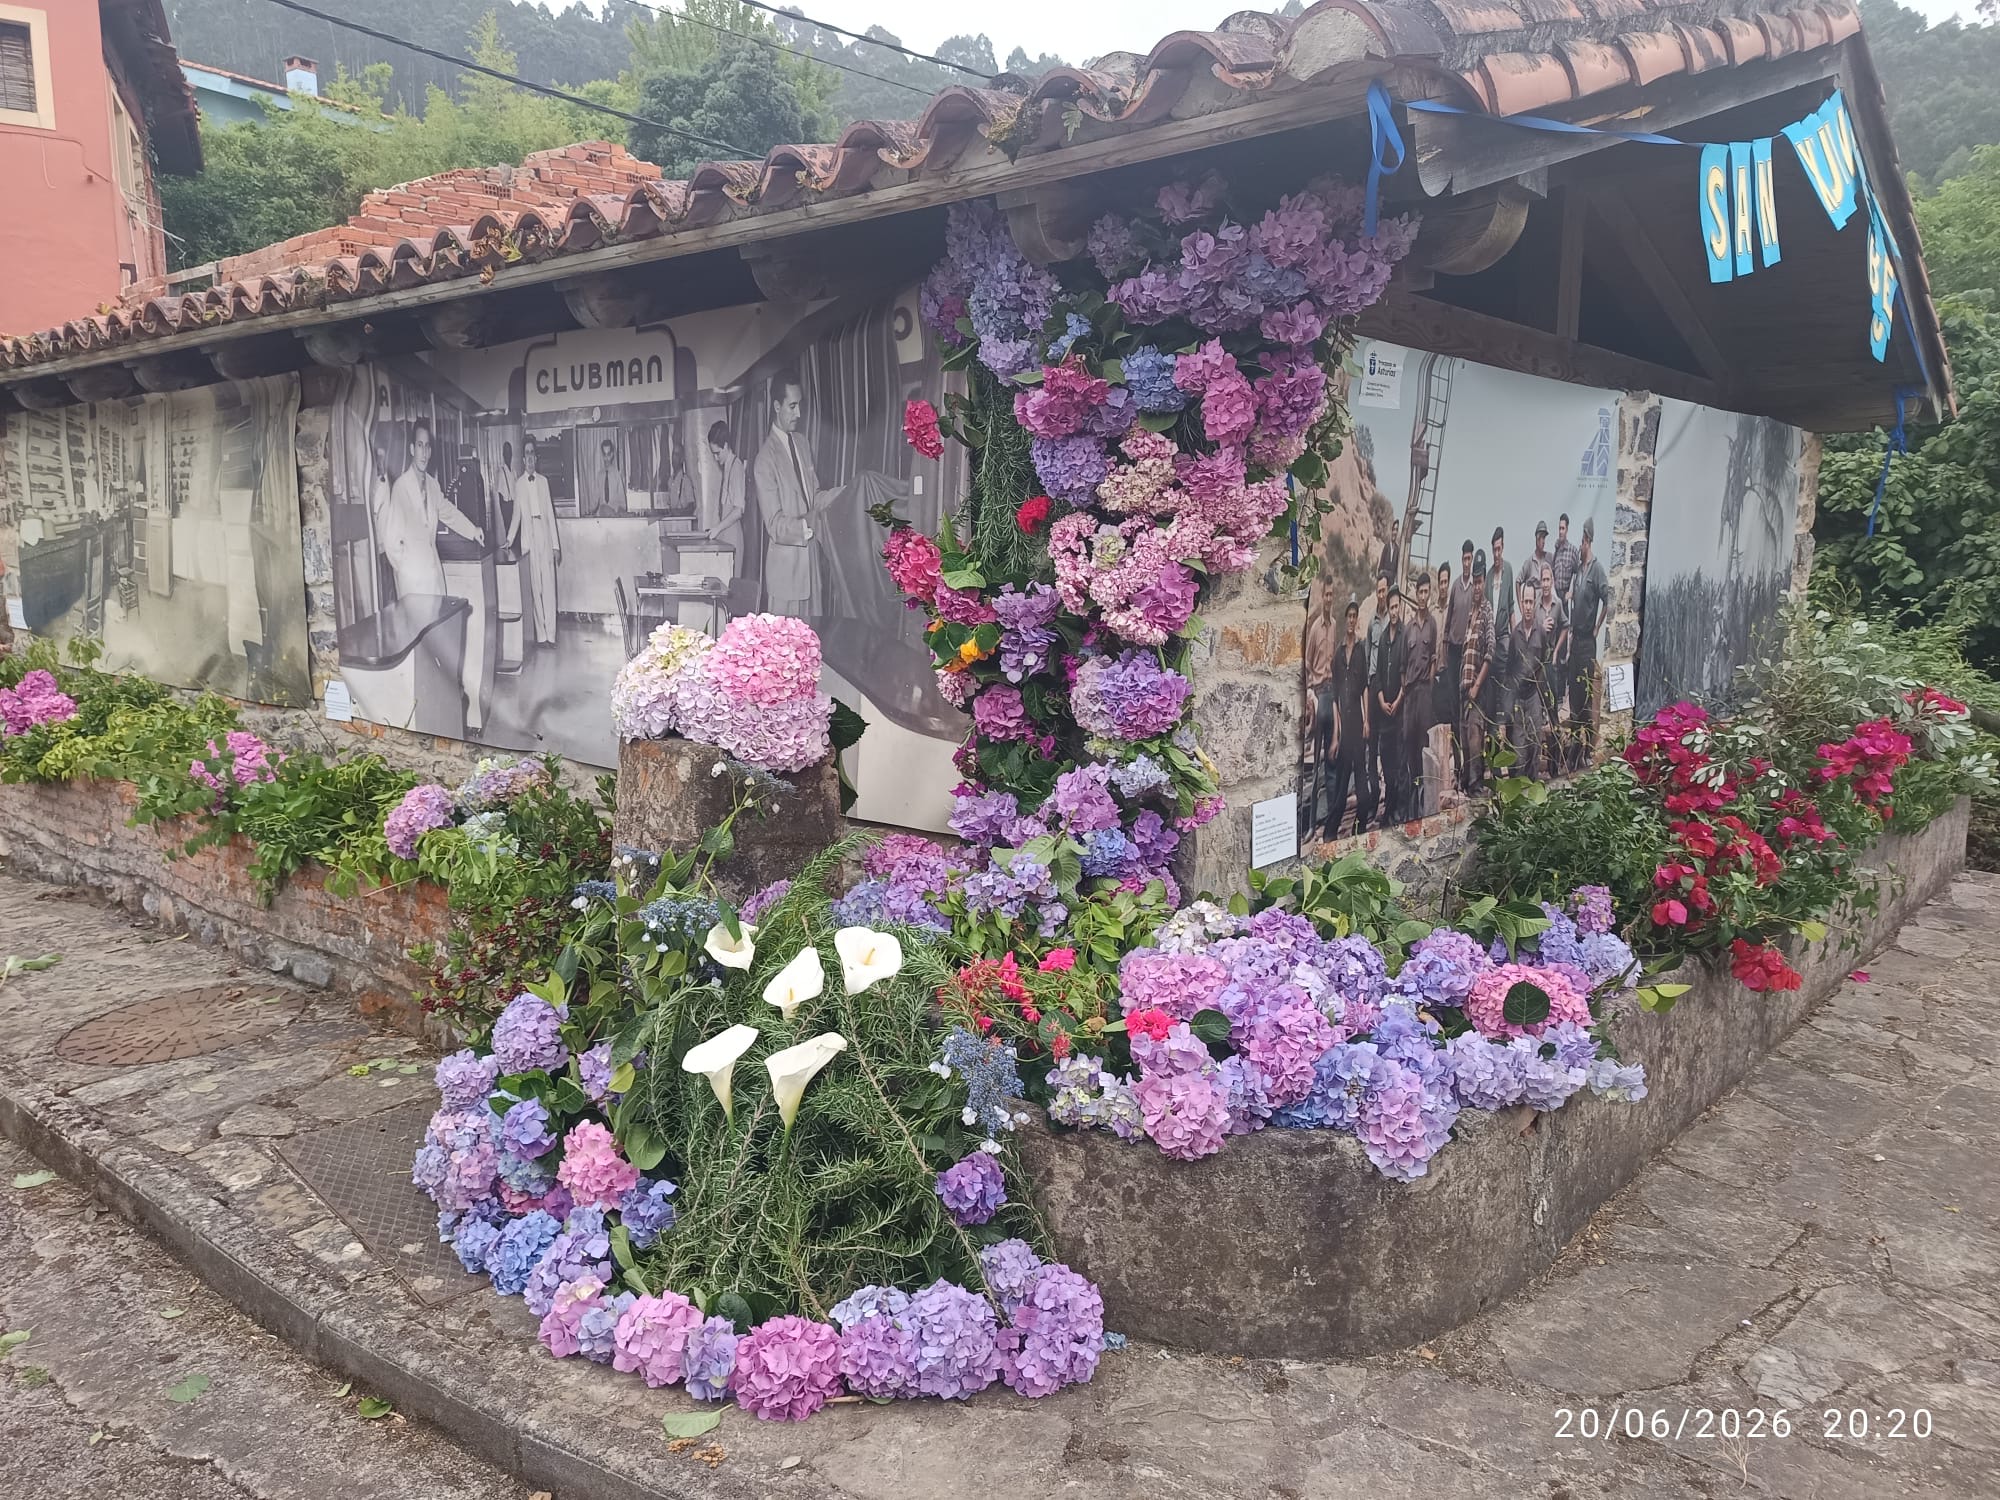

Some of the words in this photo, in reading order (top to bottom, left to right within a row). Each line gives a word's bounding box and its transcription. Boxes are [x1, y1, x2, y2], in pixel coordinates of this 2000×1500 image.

[1706, 159, 1779, 261] SAN
[535, 353, 663, 395] CLUBMAN
[1377, 366, 1397, 378] Asturias
